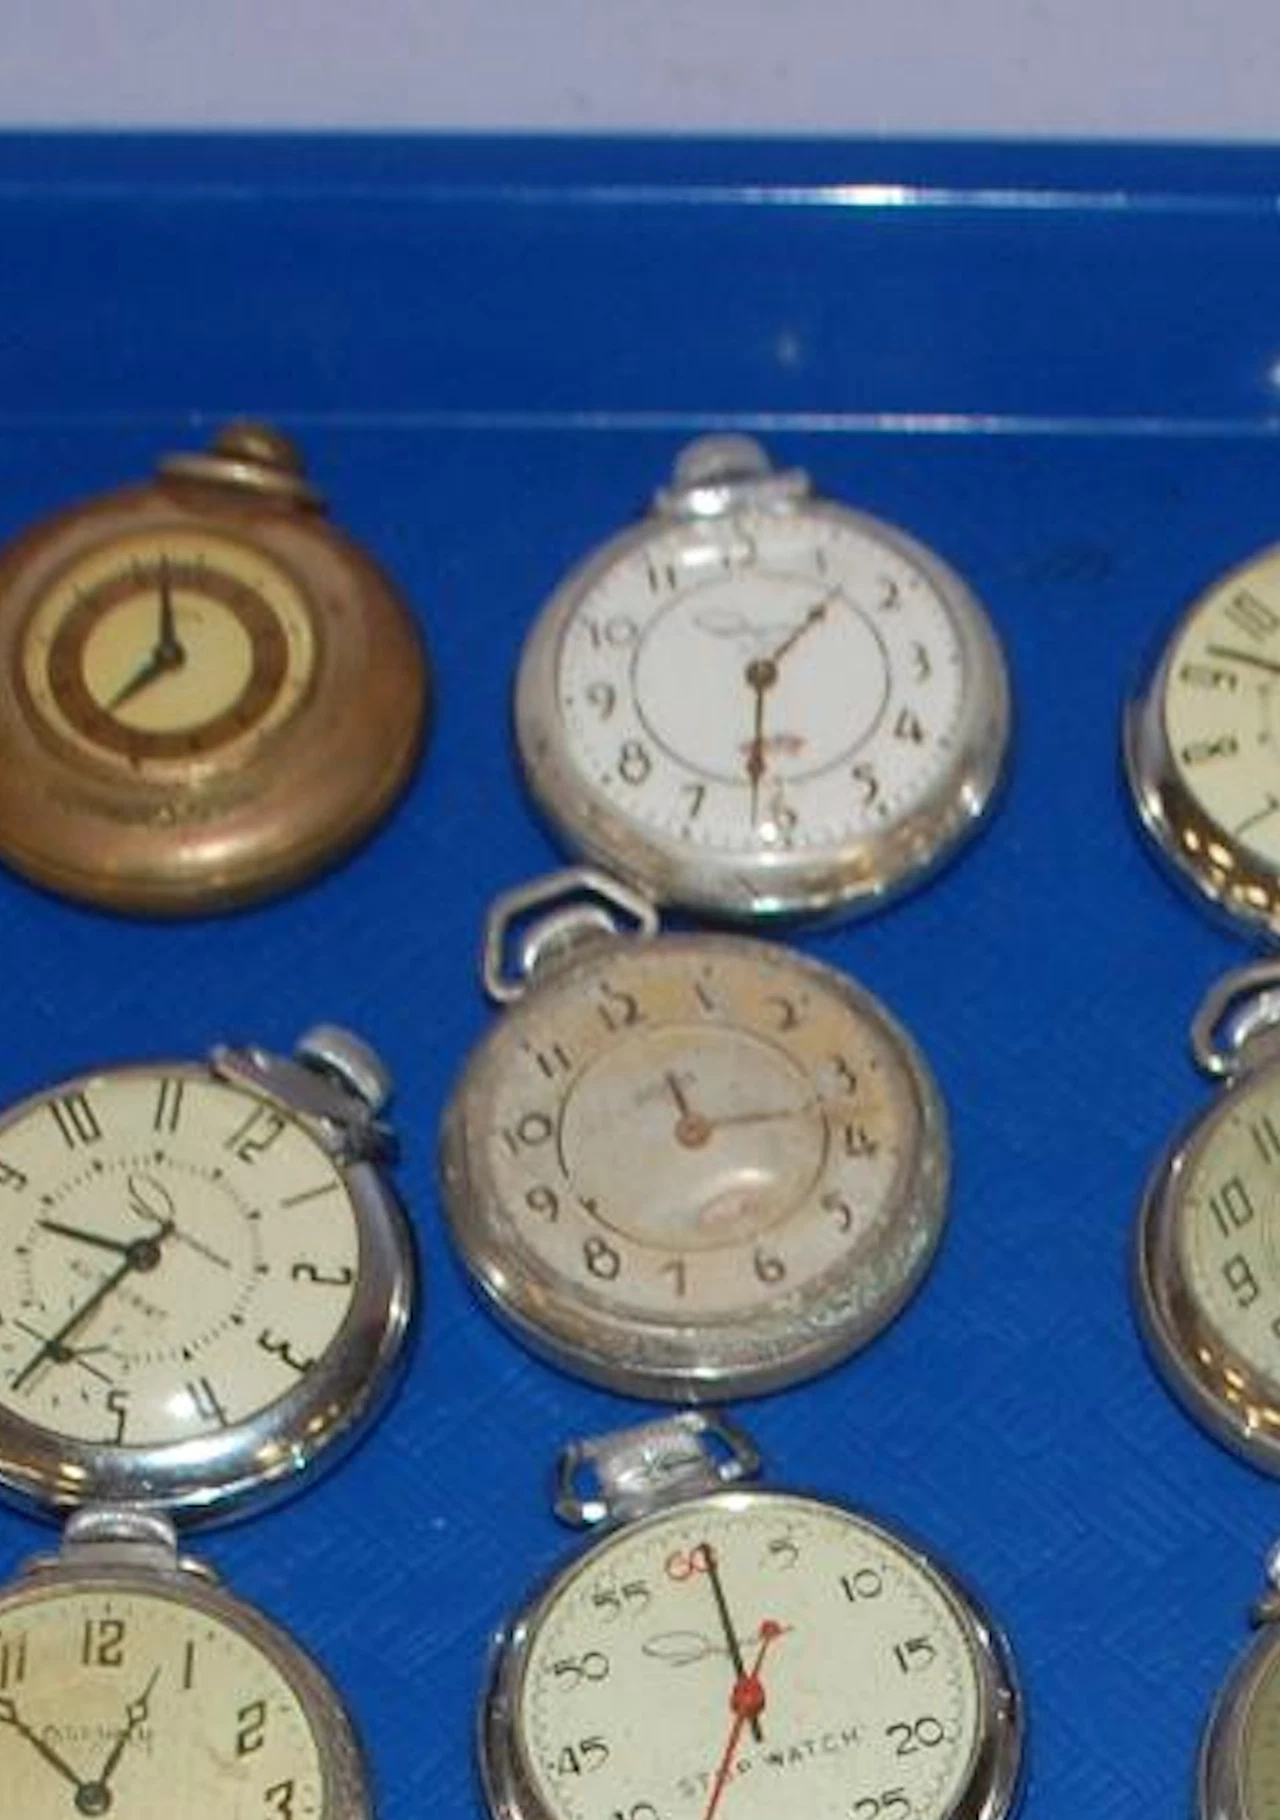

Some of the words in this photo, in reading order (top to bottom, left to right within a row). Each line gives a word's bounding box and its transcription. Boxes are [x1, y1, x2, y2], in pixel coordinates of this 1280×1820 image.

[596, 981, 638, 1032] 12
[765, 996, 799, 1031] 2
[535, 1043, 572, 1079] 11
[833, 1054, 857, 1094] 3
[48, 1091, 102, 1149] 10
[153, 1077, 184, 1132] 11
[224, 1104, 286, 1166] 12
[502, 1110, 552, 1157] 10
[845, 1124, 877, 1159] 4
[525, 1184, 560, 1223] 9
[821, 1194, 852, 1233] 5
[1209, 1177, 1254, 1239] 10
[583, 1236, 620, 1279] 8
[661, 1260, 686, 1296] 7
[754, 1247, 785, 1285] 6
[1223, 1252, 1261, 1308] 9
[258, 1328, 316, 1374] 3
[765, 1539, 800, 1572] 5
[590, 1580, 651, 1622] 55
[840, 1568, 885, 1604] 10
[81, 1619, 125, 1668] 12
[890, 1637, 939, 1677] 15
[552, 1651, 610, 1692] 50
[236, 1700, 269, 1757] 2
[764, 1726, 858, 1767] WATCH
[886, 1715, 946, 1758] 20
[554, 1736, 610, 1778] 45
